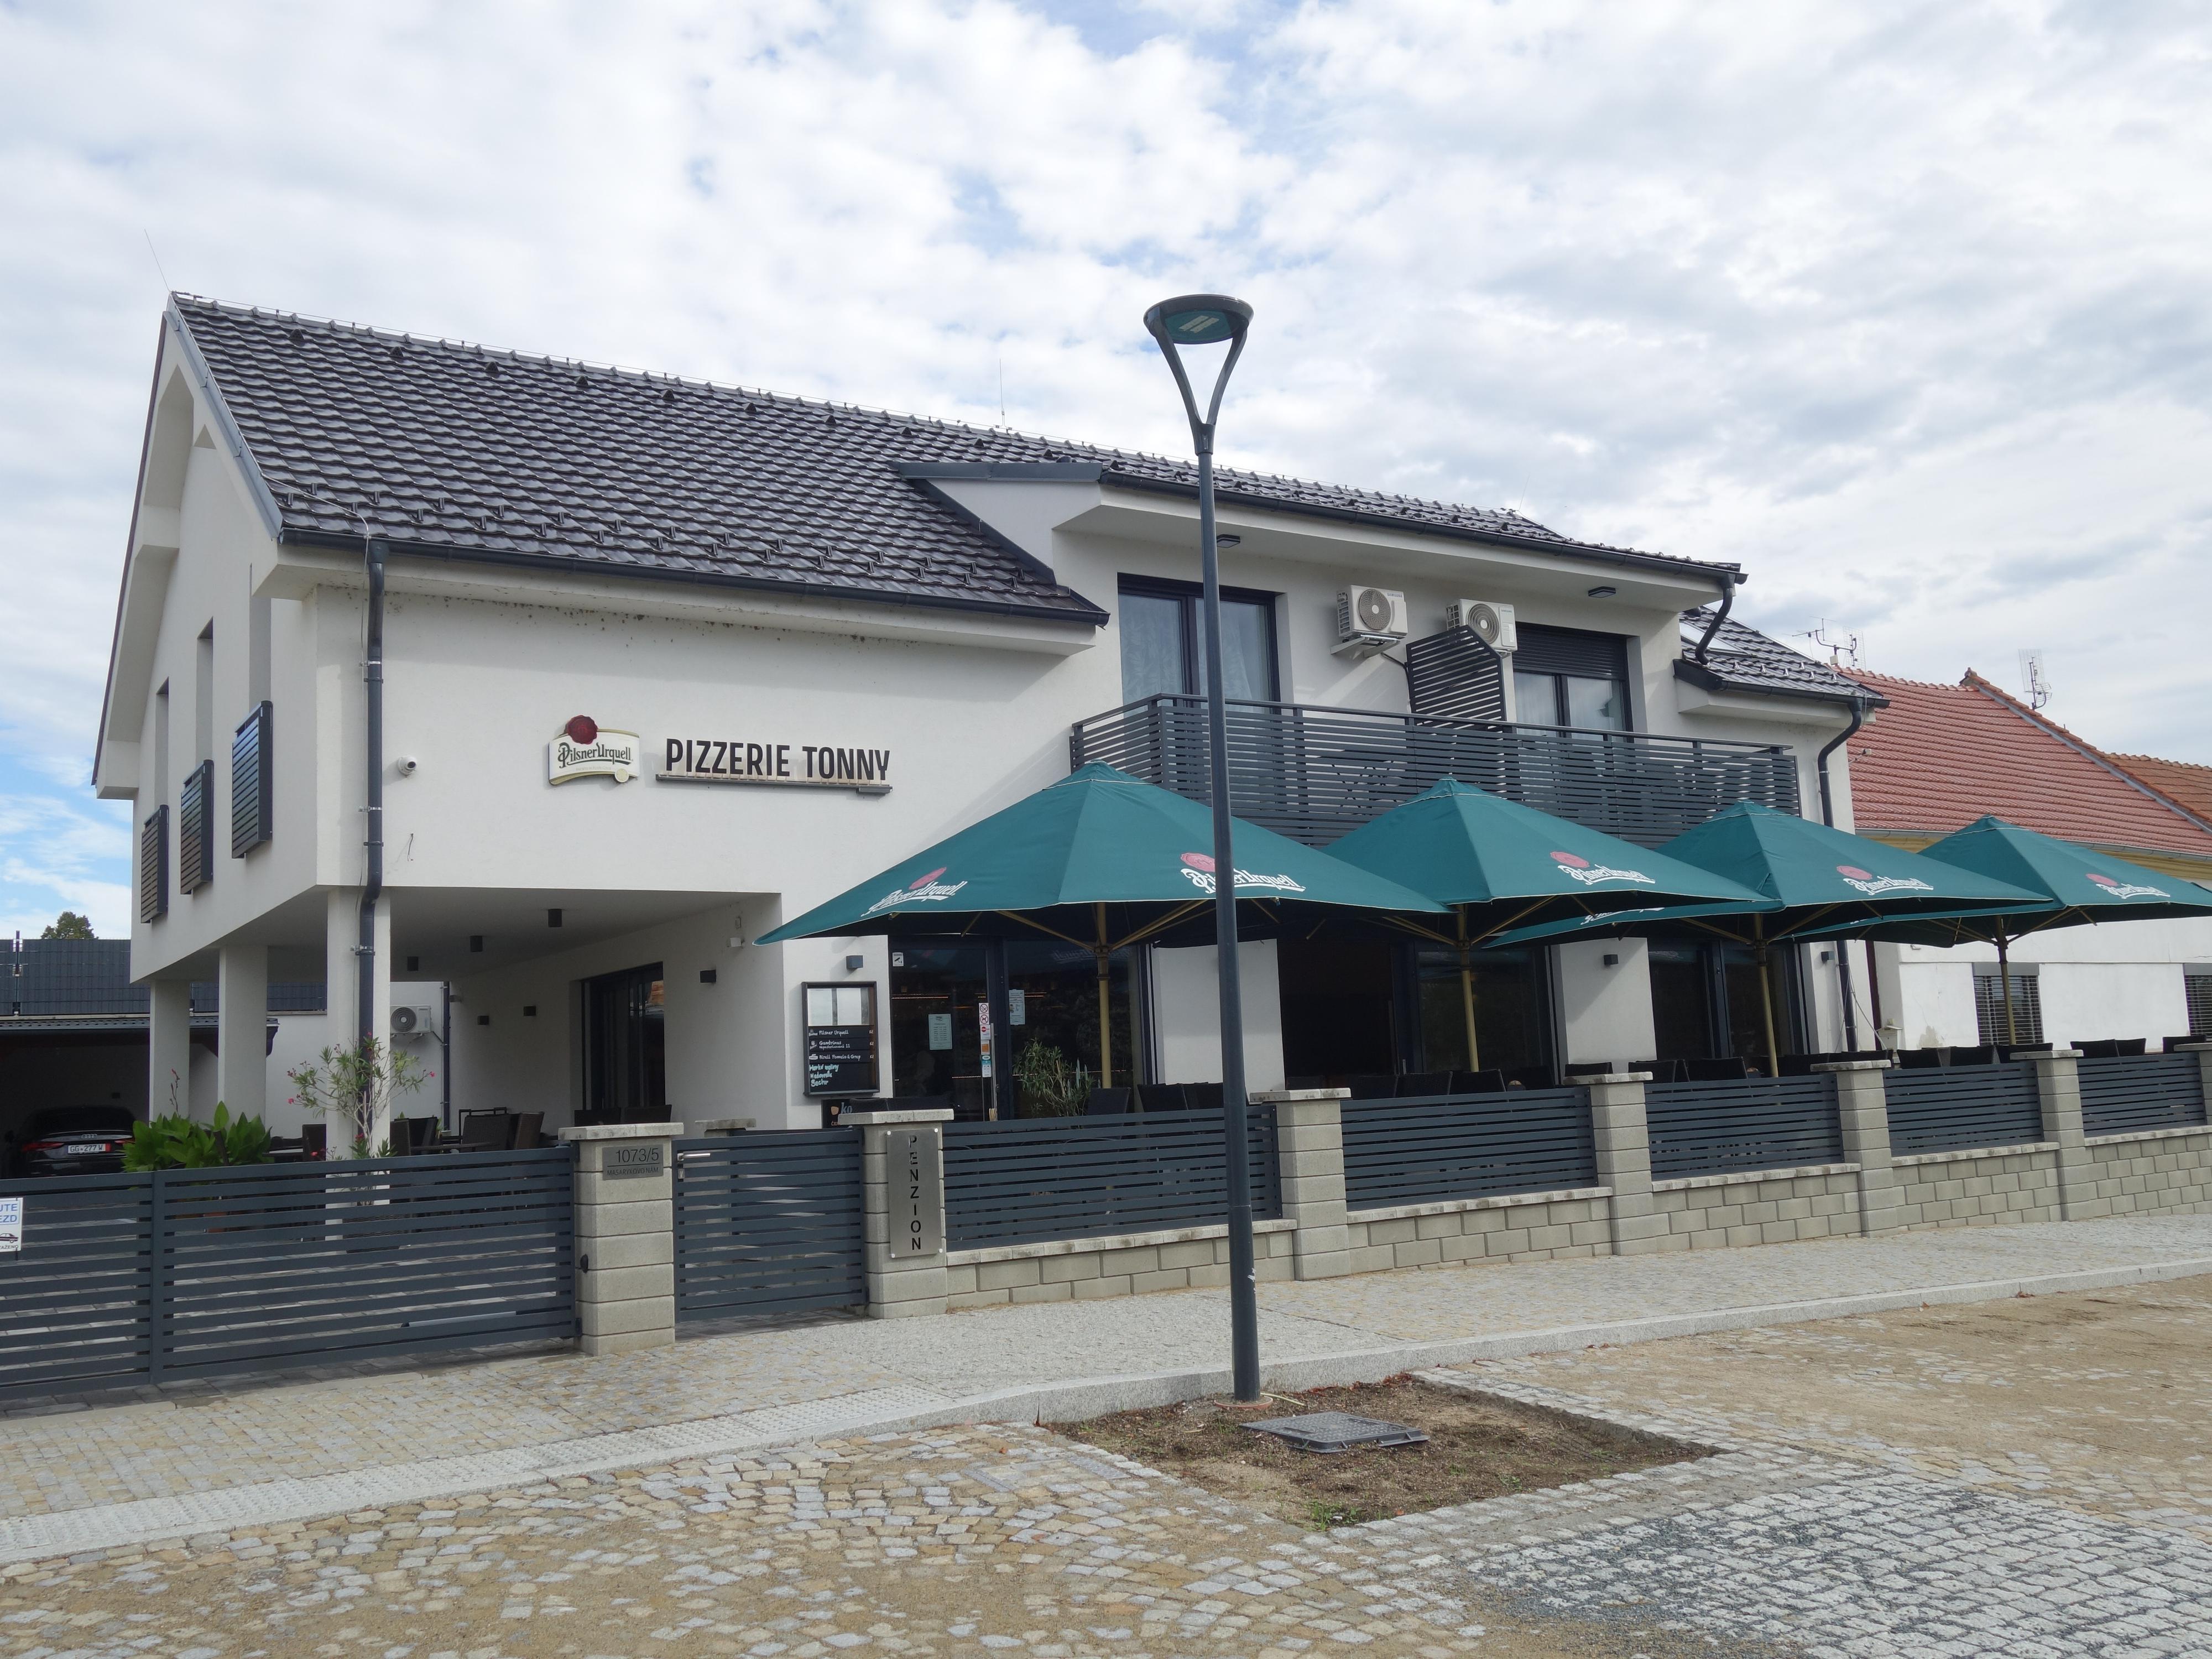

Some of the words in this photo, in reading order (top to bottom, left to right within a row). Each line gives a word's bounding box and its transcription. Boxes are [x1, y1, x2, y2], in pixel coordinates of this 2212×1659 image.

[557, 742, 597, 769] Pilsner
[596, 742, 631, 765] Urquell
[666, 738, 790, 776] PIZZERIE
[802, 746, 890, 780] TONNY
[1234, 868, 1302, 890] Urquell
[615, 1147, 659, 1162] 1073/5
[607, 1168, 645, 1176] MASARYKOVO
[909, 1135, 921, 1250] PENZION
